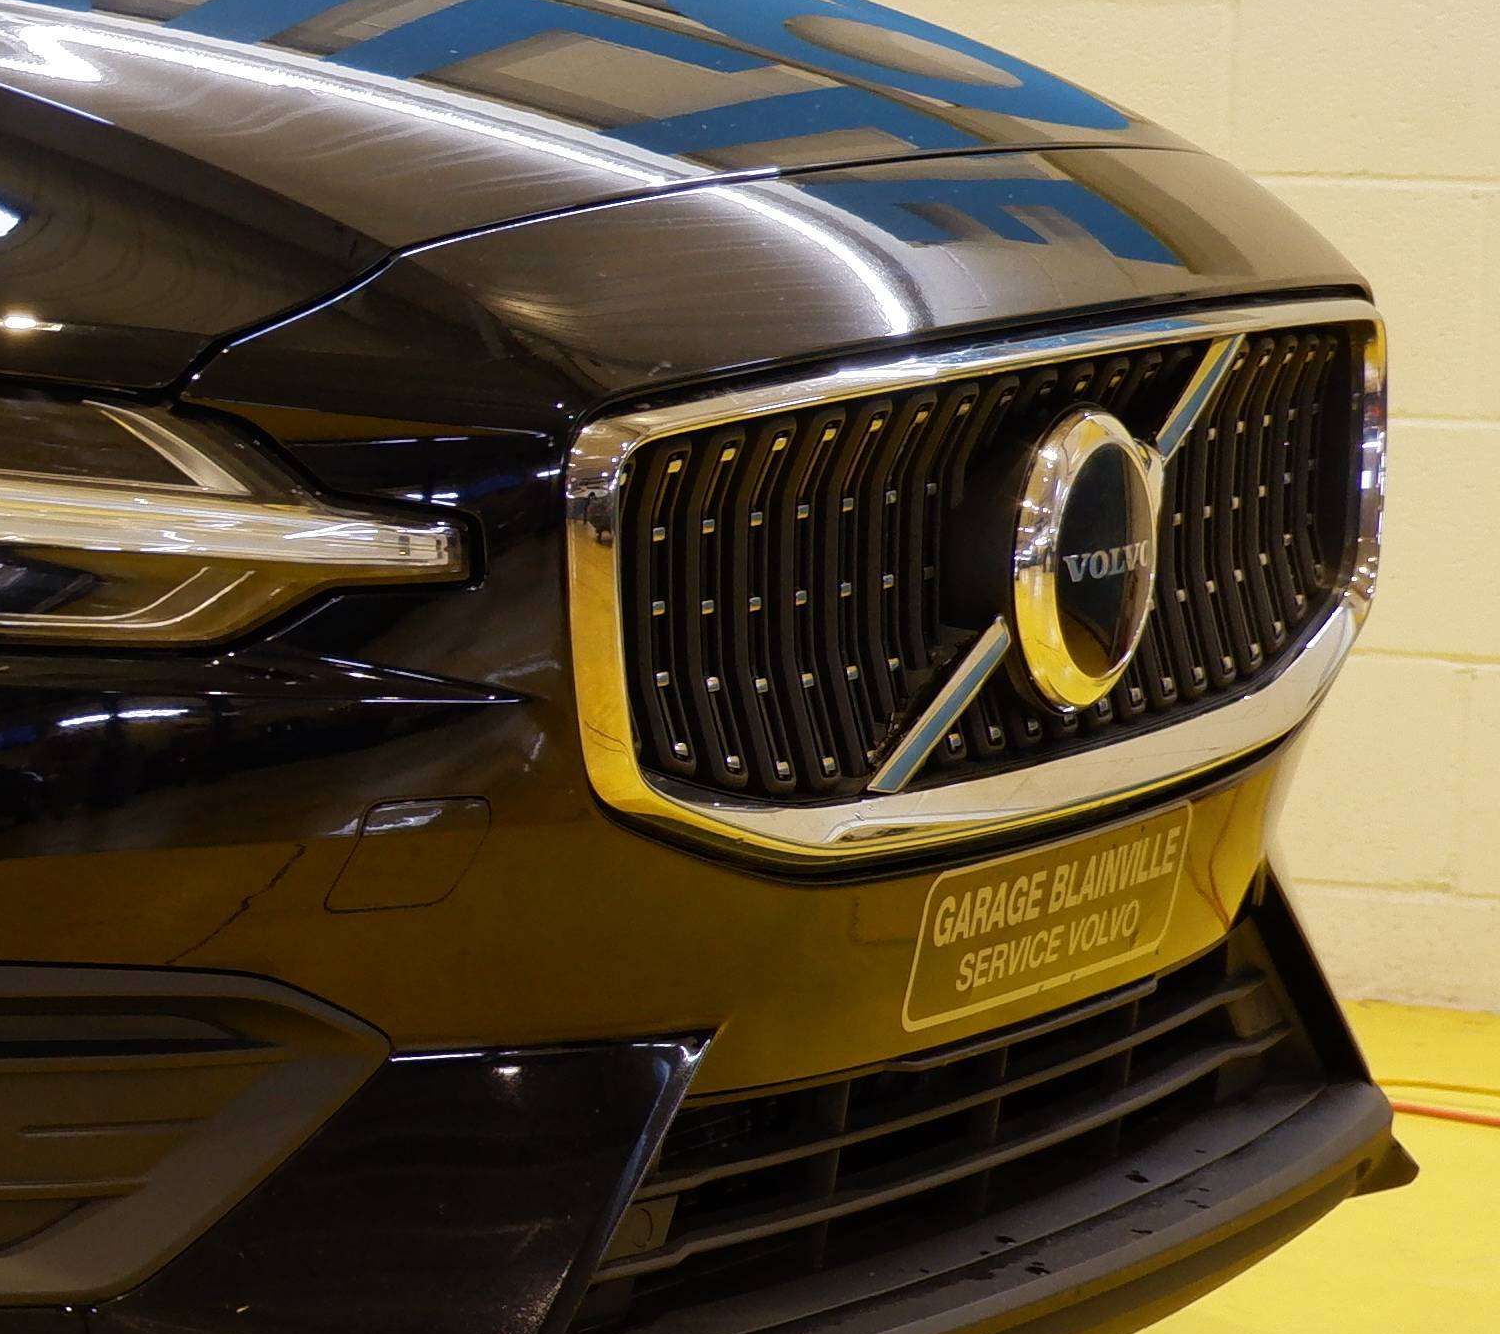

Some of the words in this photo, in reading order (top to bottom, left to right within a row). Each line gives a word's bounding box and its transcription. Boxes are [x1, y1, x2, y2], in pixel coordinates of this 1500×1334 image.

[933, 870, 1047, 947] GARAGE
[1048, 826, 1181, 914] BLAINVILLE
[955, 925, 1065, 993] SERVICE
[1067, 899, 1140, 956] VOLVO
